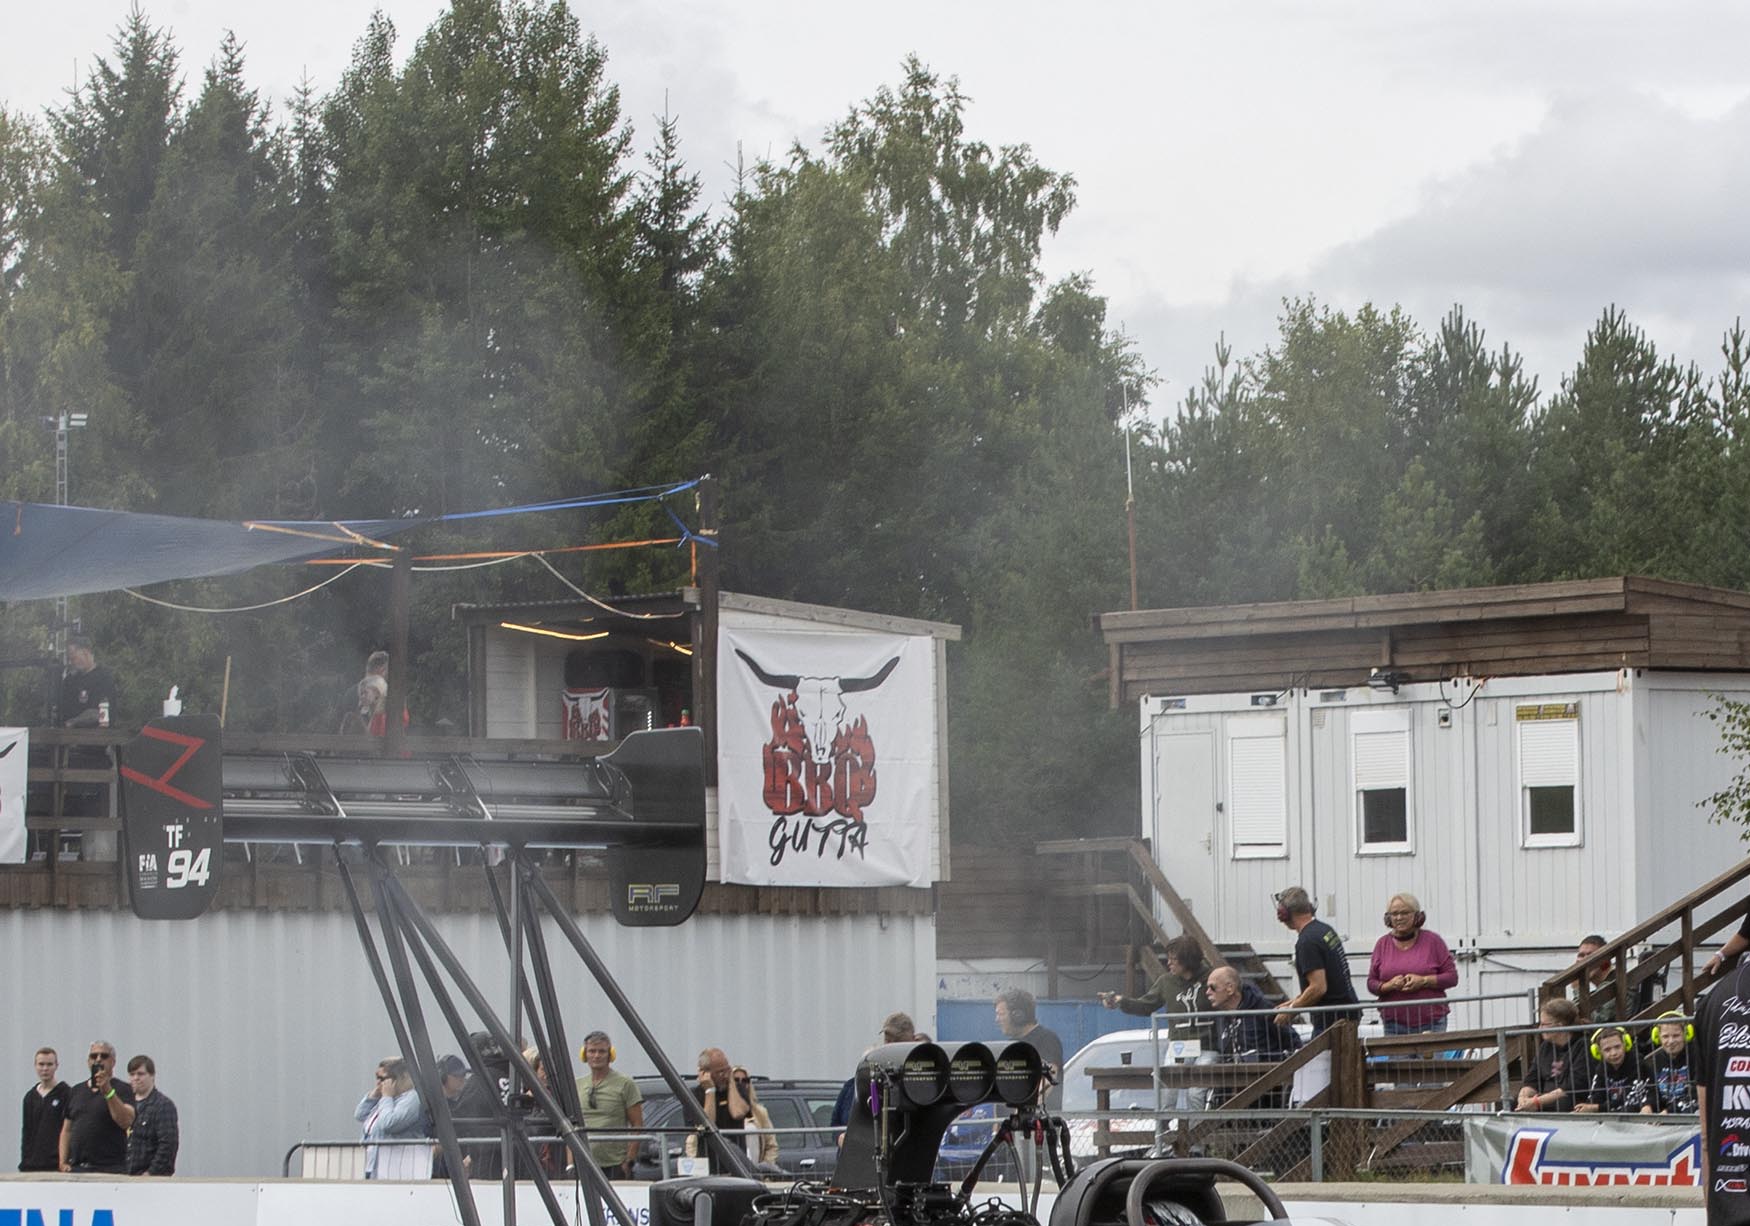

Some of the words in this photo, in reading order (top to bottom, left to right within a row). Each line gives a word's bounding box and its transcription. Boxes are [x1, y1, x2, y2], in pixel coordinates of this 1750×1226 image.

[763, 735, 878, 823] BBQ
[166, 825, 183, 848] TF
[769, 815, 868, 866] GUTTA
[167, 848, 211, 888] 94
[628, 884, 680, 904] RF
